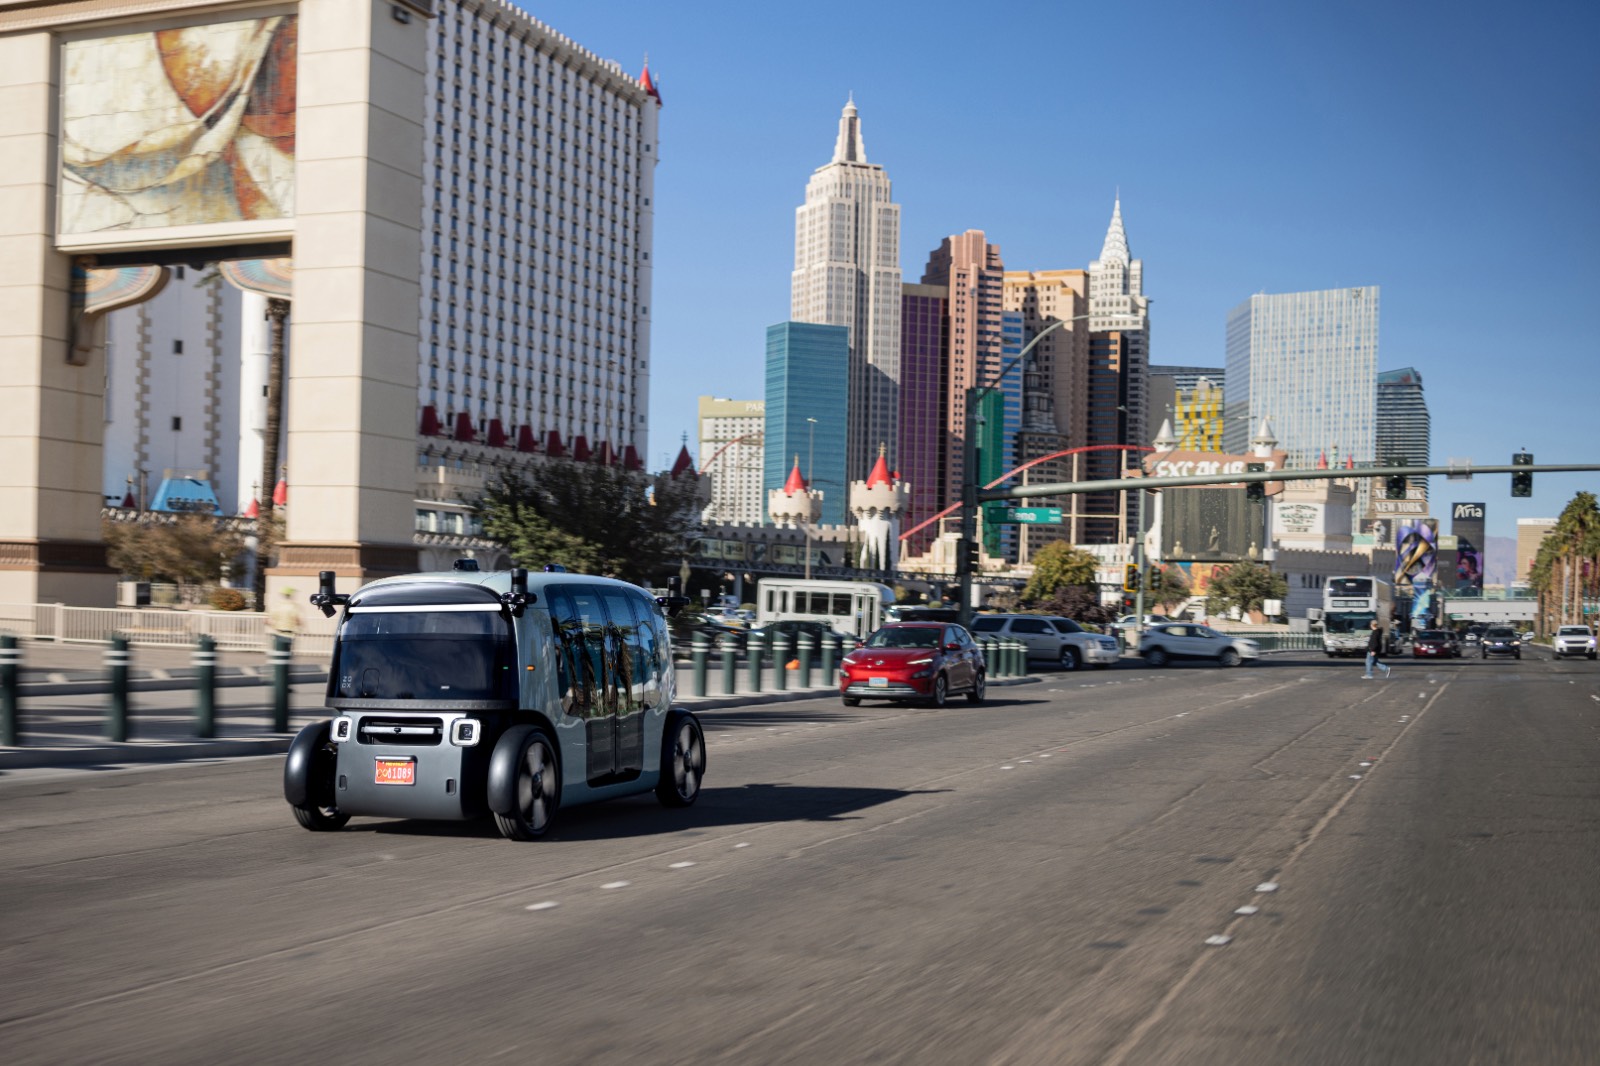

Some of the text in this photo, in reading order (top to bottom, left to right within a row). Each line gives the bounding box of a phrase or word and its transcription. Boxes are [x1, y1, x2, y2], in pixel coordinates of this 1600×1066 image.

[1154, 460, 1276, 478] EXCALIBR
[1375, 502, 1423, 512] NEW YORK
